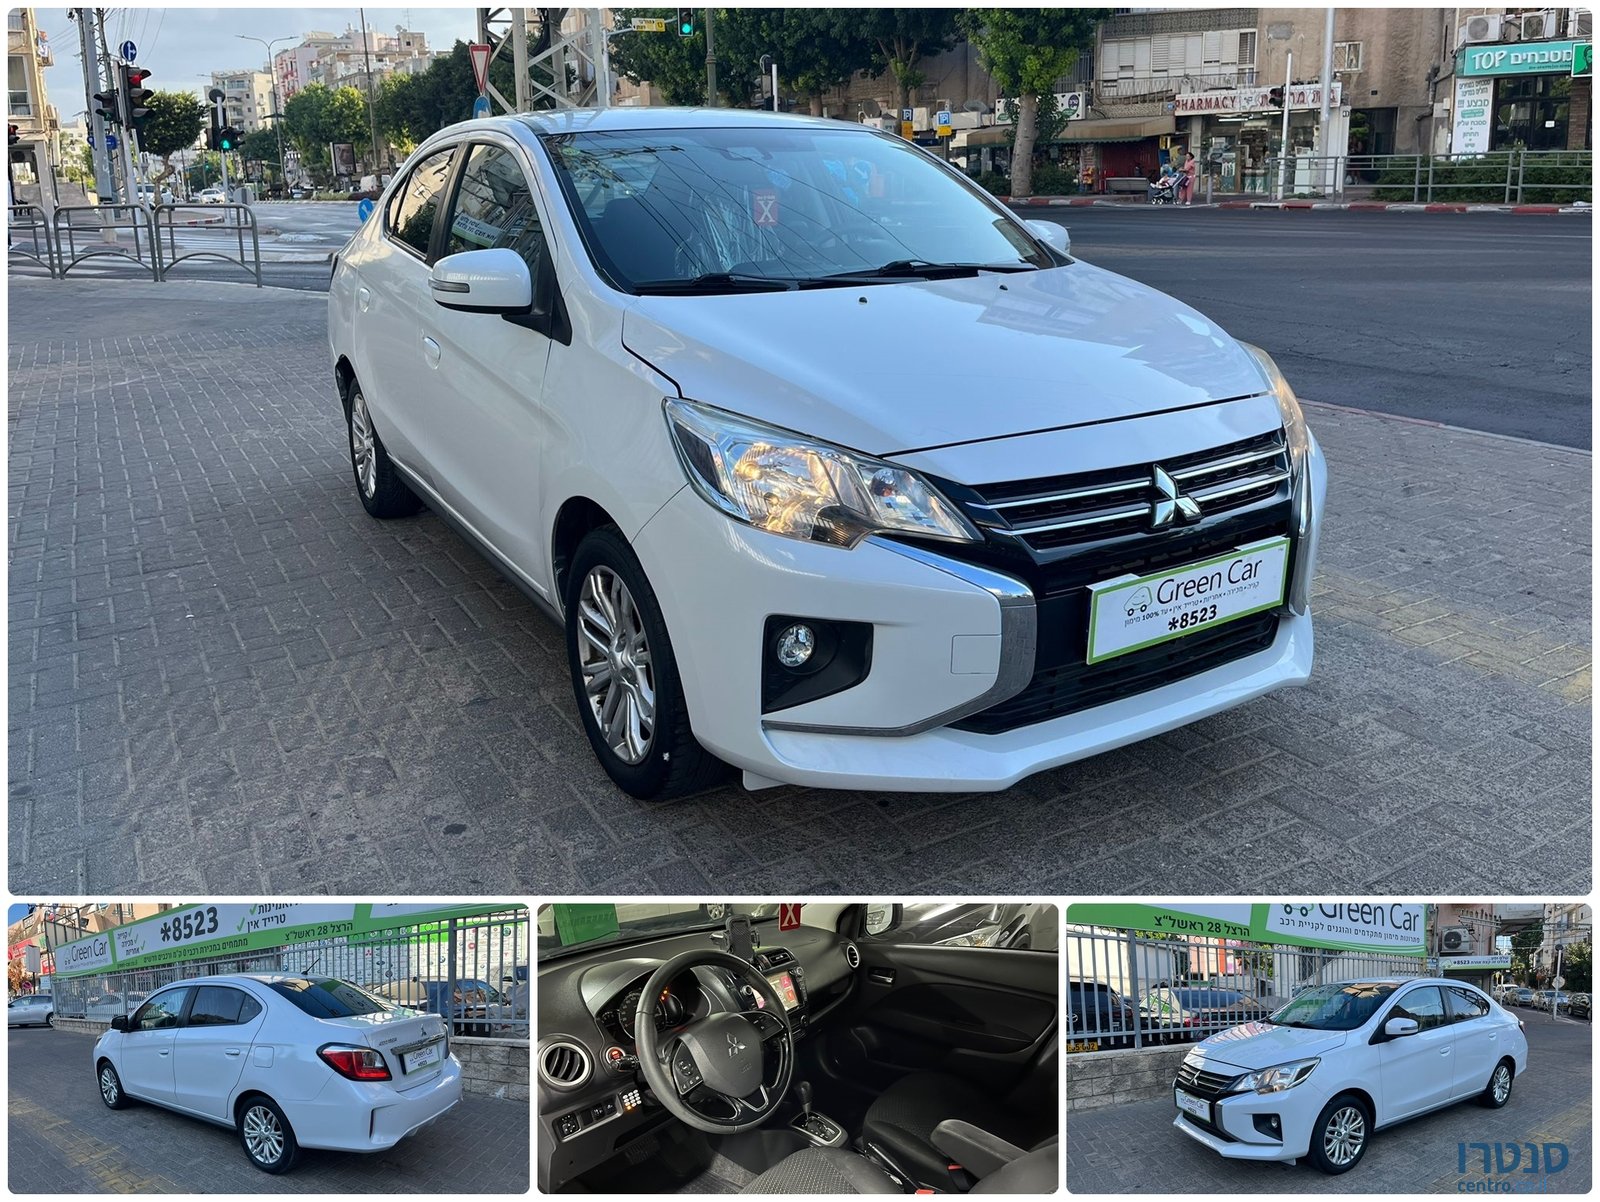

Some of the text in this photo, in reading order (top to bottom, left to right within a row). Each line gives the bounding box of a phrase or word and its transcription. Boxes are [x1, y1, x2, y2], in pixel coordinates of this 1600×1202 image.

[1471, 50, 1508, 70] TOP
[1510, 49, 1572, 65] מטבחים
[1175, 96, 1237, 112] PHARMACY
[1467, 98, 1490, 107] מבצע
[1157, 559, 1263, 605] Green Car
[1141, 610, 1160, 621] 100%
[247, 913, 286, 933] טרייד אין
[1280, 917, 1295, 927] רכב
[1318, 903, 1419, 932] Green Car
[317, 926, 328, 937] 28
[331, 922, 353, 934] הרצל
[1207, 921, 1222, 933] 28
[1224, 923, 1250, 937] הרצל
[1298, 920, 1325, 931] לקניית
[1327, 924, 1352, 935] והוגנים
[1354, 928, 1383, 939] מתקדמים
[1383, 933, 1399, 942] מימון
[200, 943, 221, 954] במכירת
[222, 937, 248, 949] מתמחים
[71, 938, 107, 962] Green Car
